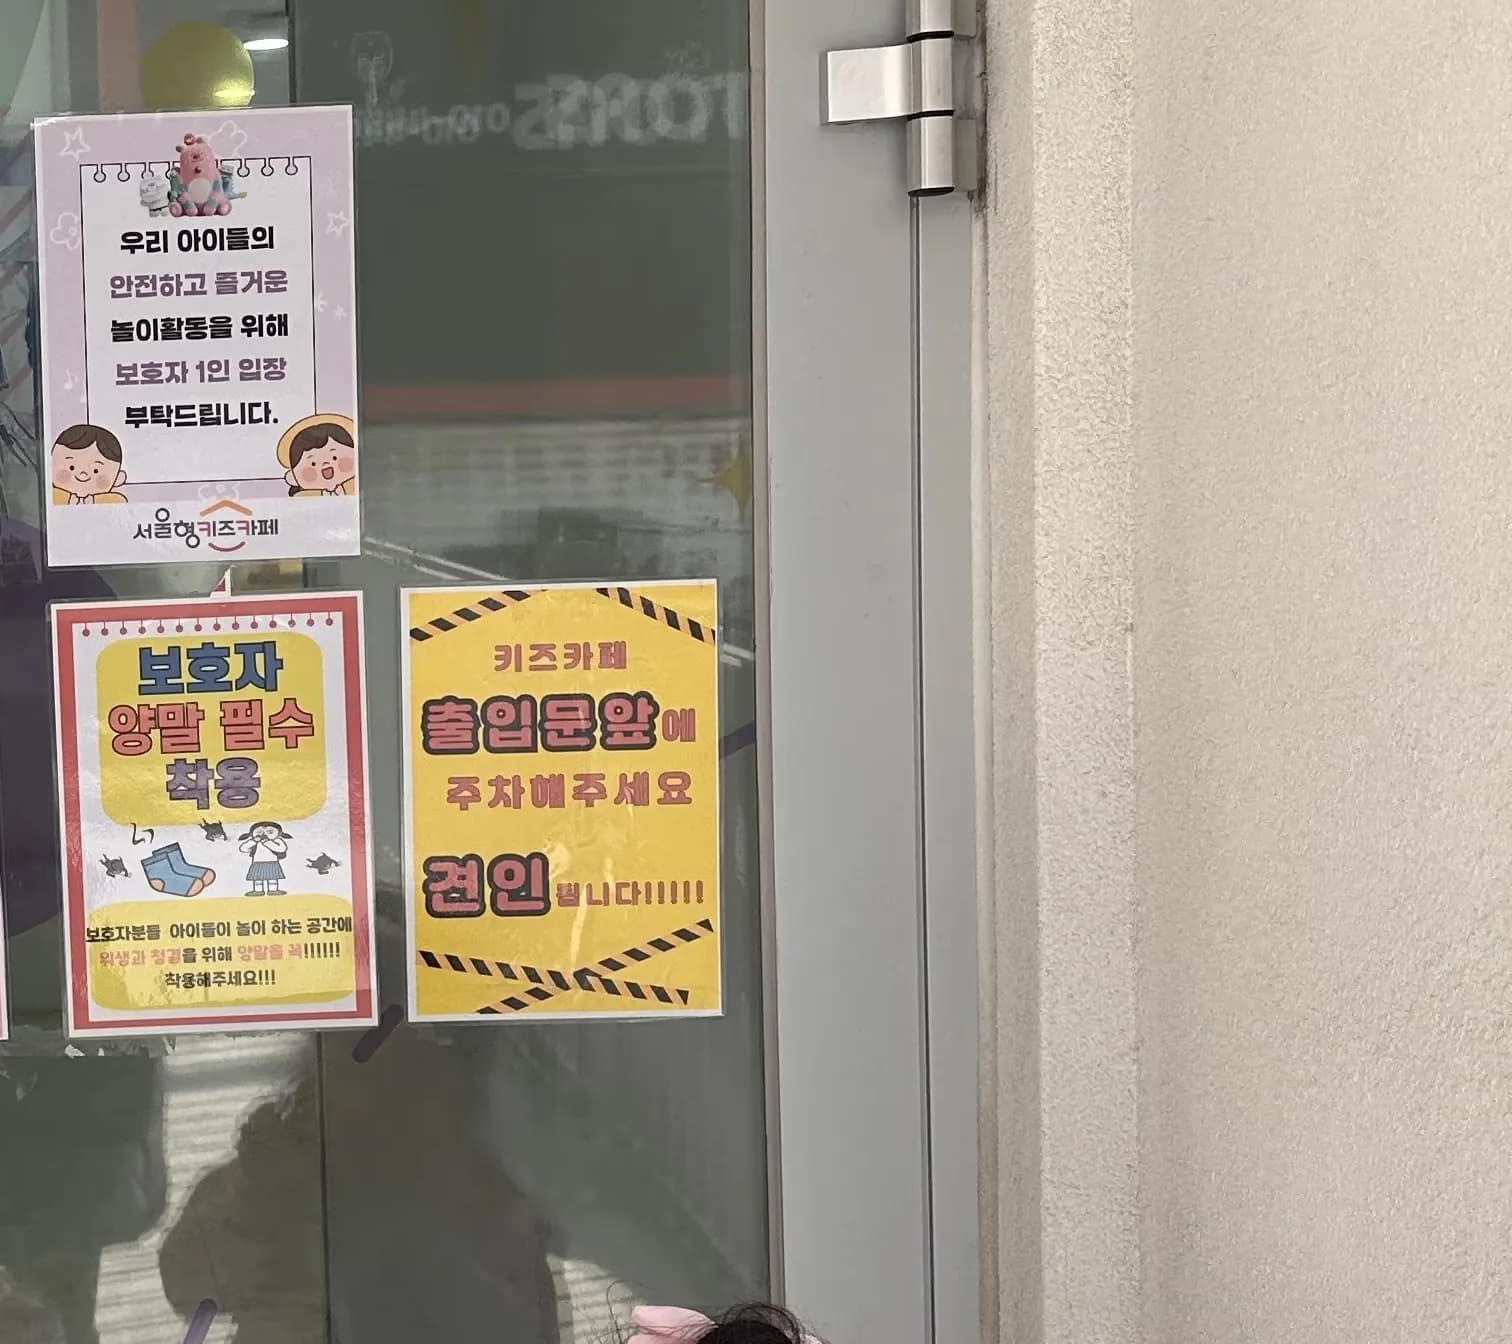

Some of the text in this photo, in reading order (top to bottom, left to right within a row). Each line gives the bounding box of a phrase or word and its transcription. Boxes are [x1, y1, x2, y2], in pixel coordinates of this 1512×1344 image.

[119, 225, 275, 255] 우리 아이들의
[109, 269, 289, 300] 안전하고 즐거운
[110, 313, 289, 343] 놀이활동을 위해
[115, 357, 287, 387] 보호자 1인 입장
[124, 401, 280, 429] 부탁드립니다.
[138, 641, 284, 696] 보호자
[493, 640, 628, 673] 키즈카페
[107, 697, 315, 757] 양말 필수
[165, 757, 262, 810] 착용
[445, 770, 693, 812] 주차해주세요
[85, 916, 353, 944] 보호자분들 아이들이 놀이 하는 공간에
[201, 946, 233, 963] 위해
[237, 944, 284, 962] 양말을
[164, 969, 277, 990] 착용해주세요!!!
